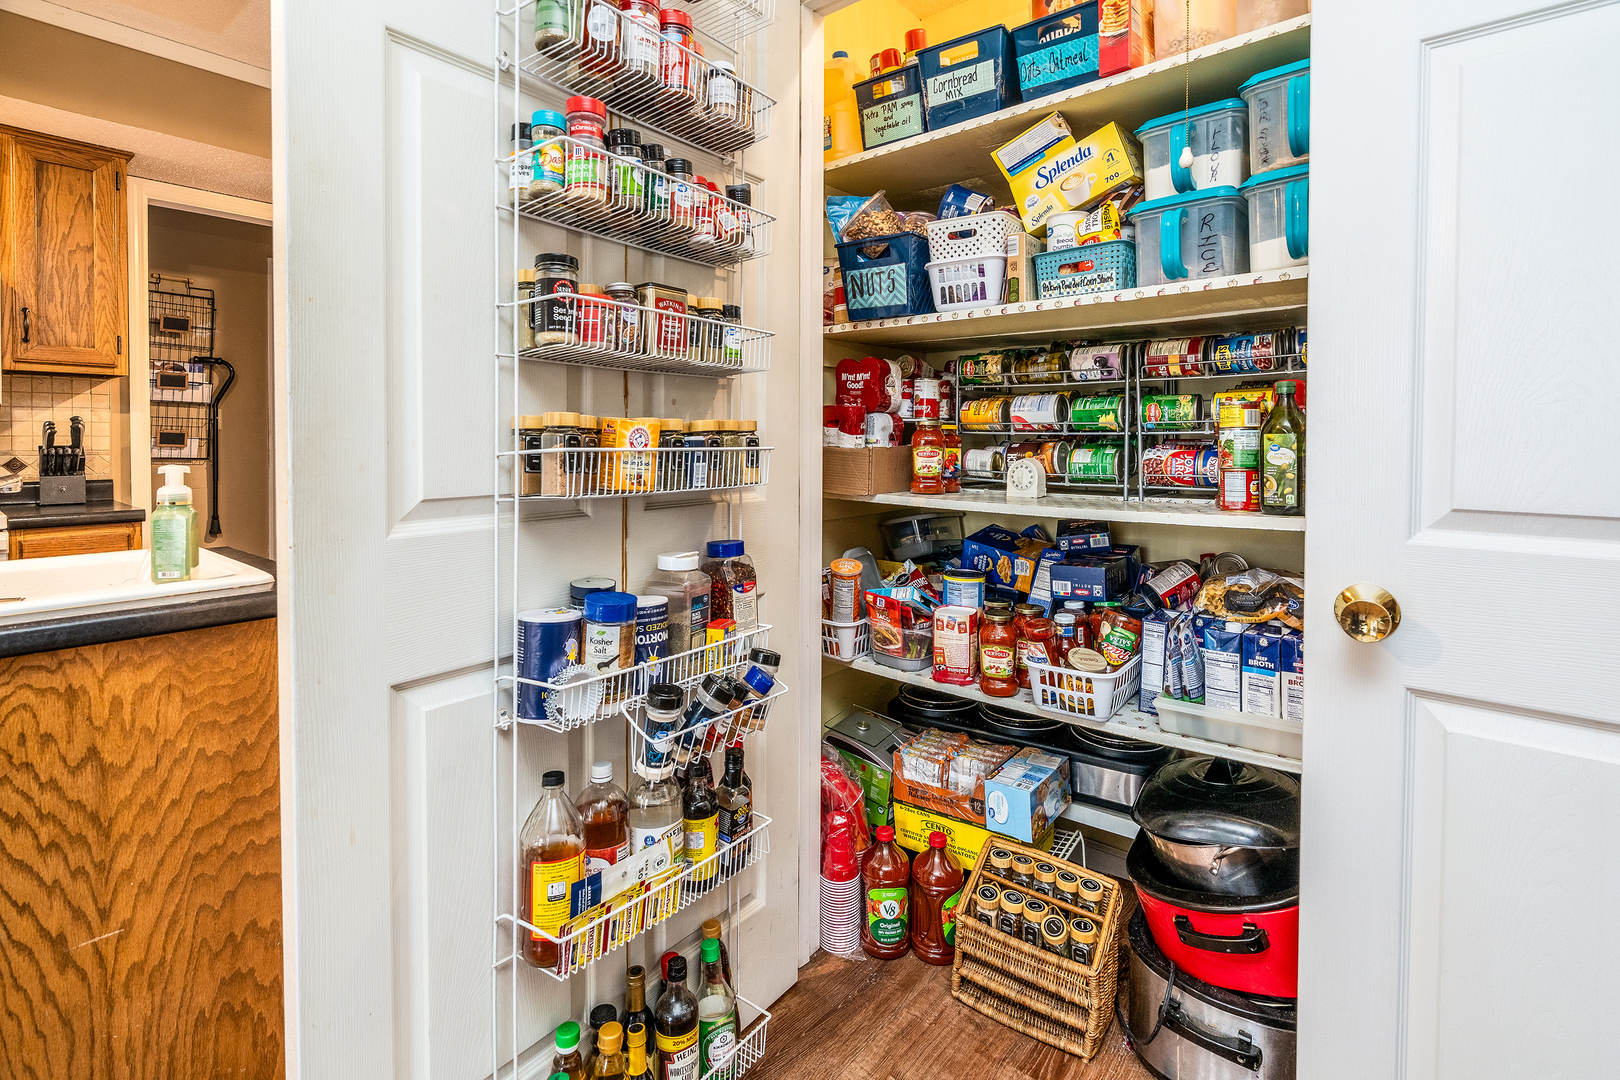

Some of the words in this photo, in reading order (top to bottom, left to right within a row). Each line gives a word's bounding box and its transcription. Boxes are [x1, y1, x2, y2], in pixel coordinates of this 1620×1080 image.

[933, 64, 978, 94] Cornbread
[945, 87, 963, 101] MIX
[881, 101, 897, 114] PAM
[883, 113, 893, 121] and
[1035, 146, 1091, 189] Splenda
[1105, 172, 1119, 183] 700
[1032, 204, 1054, 227] Splenda
[1198, 213, 1219, 273] RICE
[850, 269, 896, 300] NUTS
[658, 301, 682, 312] WATKINS
[846, 381, 864, 389] Good!
[1183, 454, 1193, 480] JOAN
[589, 636, 613, 646] Kosher
[1110, 634, 1131, 646] SALSA
[593, 646, 607, 654] Salt
[1101, 641, 1131, 661] Pace
[1248, 659, 1274, 669] BROTH
[974, 801, 981, 810] 12
[916, 810, 930, 818] CANS
[900, 828, 923, 838] CERTIFIED
[925, 822, 952, 836] CENTO
[903, 833, 922, 843] WHOLE
[883, 903, 896, 916] V8
[880, 921, 900, 929] Original
[676, 1045, 697, 1061] HEINZ
